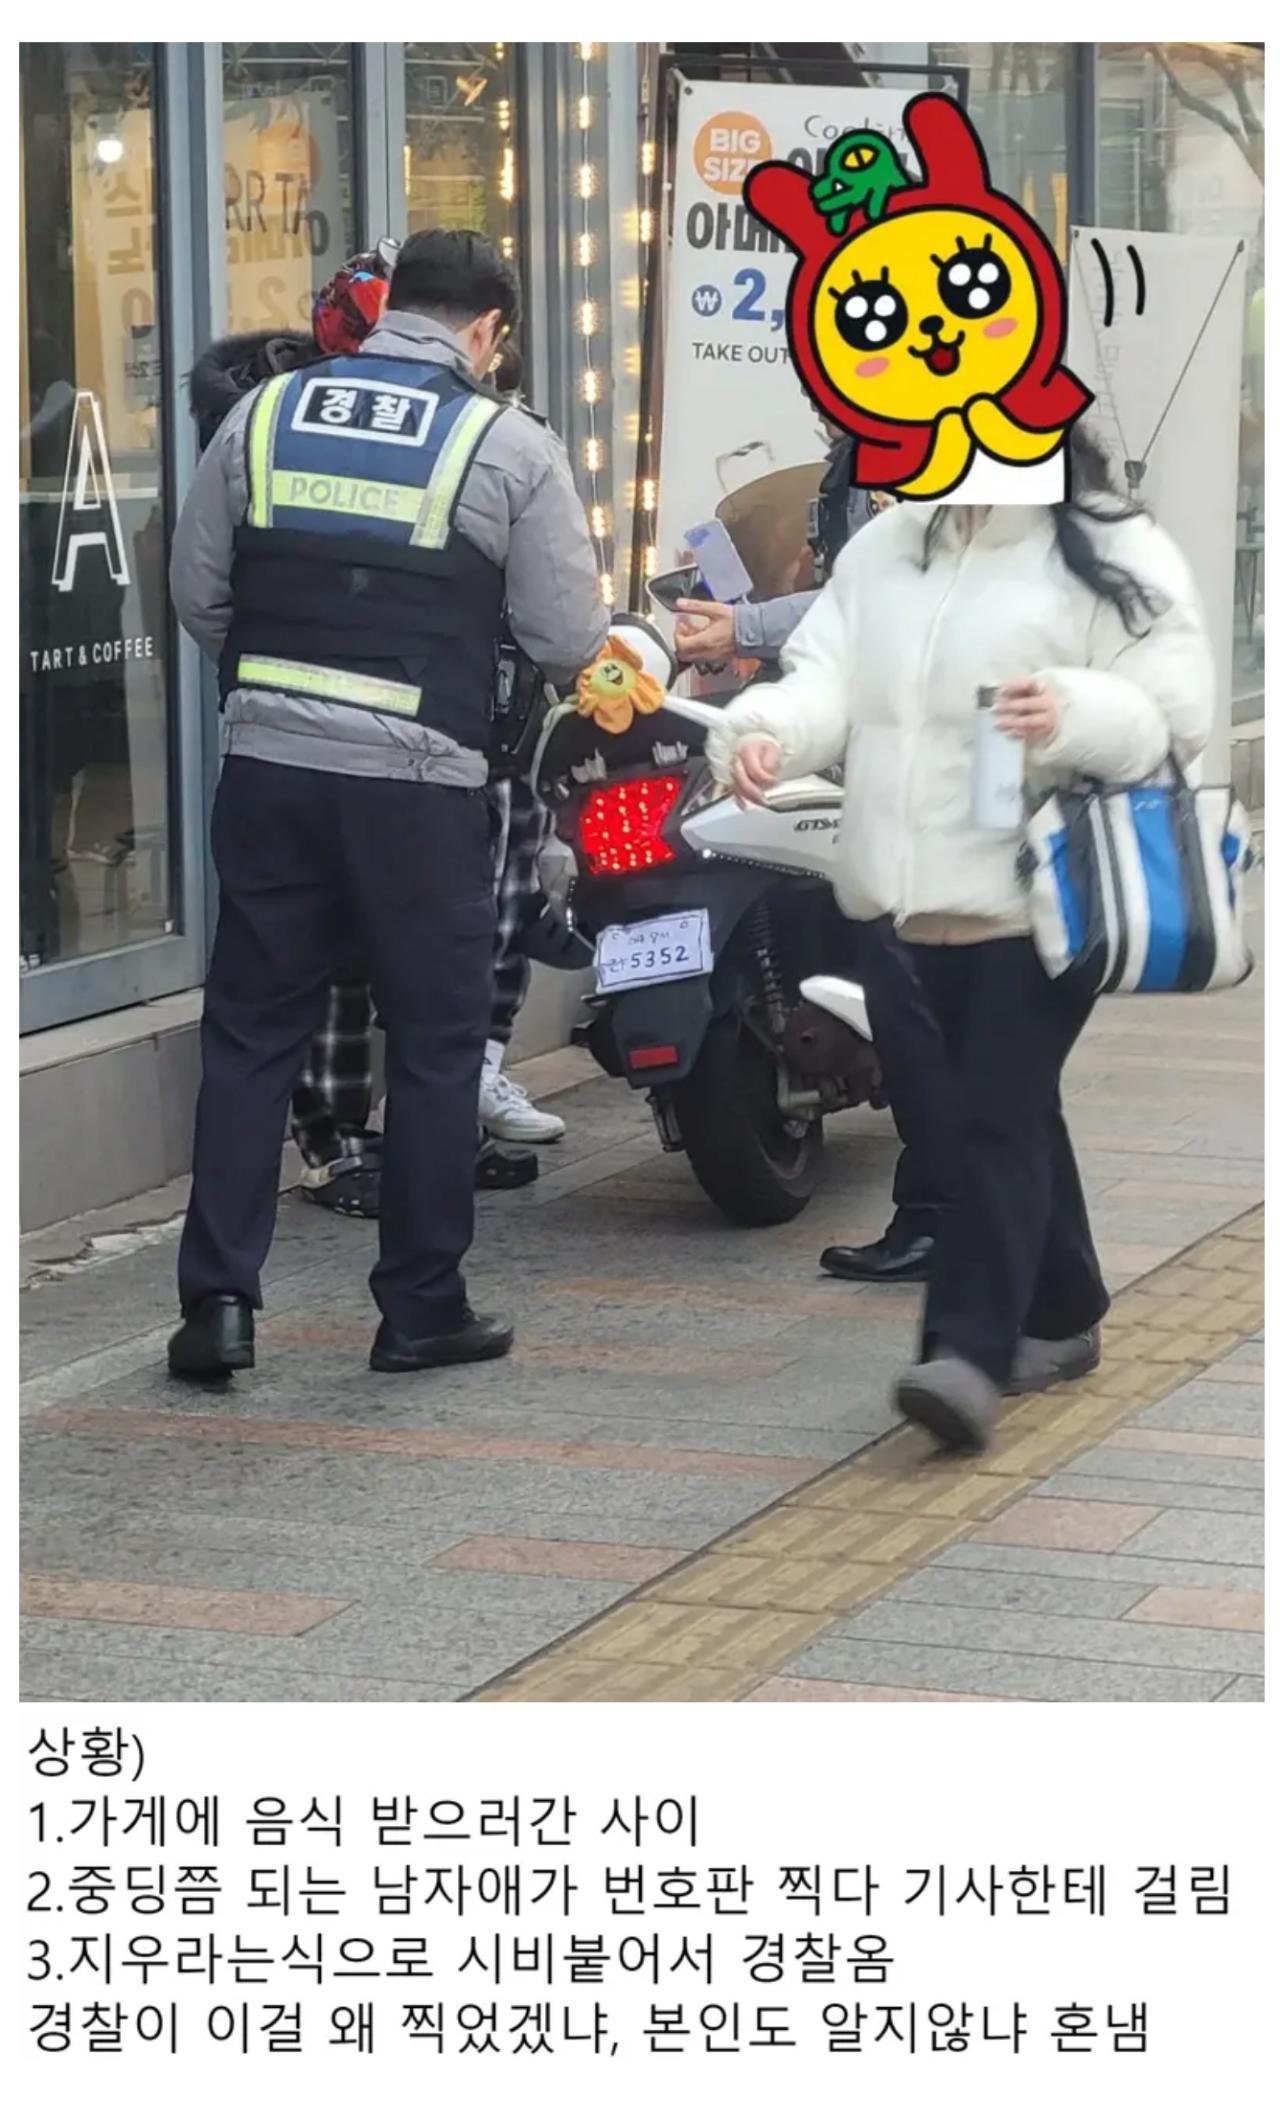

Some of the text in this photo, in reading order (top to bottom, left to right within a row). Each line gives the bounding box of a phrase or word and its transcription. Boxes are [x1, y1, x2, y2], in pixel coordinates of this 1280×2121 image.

[710, 128, 761, 153] BIG
[692, 342, 790, 364] TAKE OUT
[320, 388, 412, 431] 경찰
[52, 392, 131, 592] A
[289, 476, 400, 515] POLICE
[30, 646, 74, 672] TART
[92, 636, 153, 664] COFFEE
